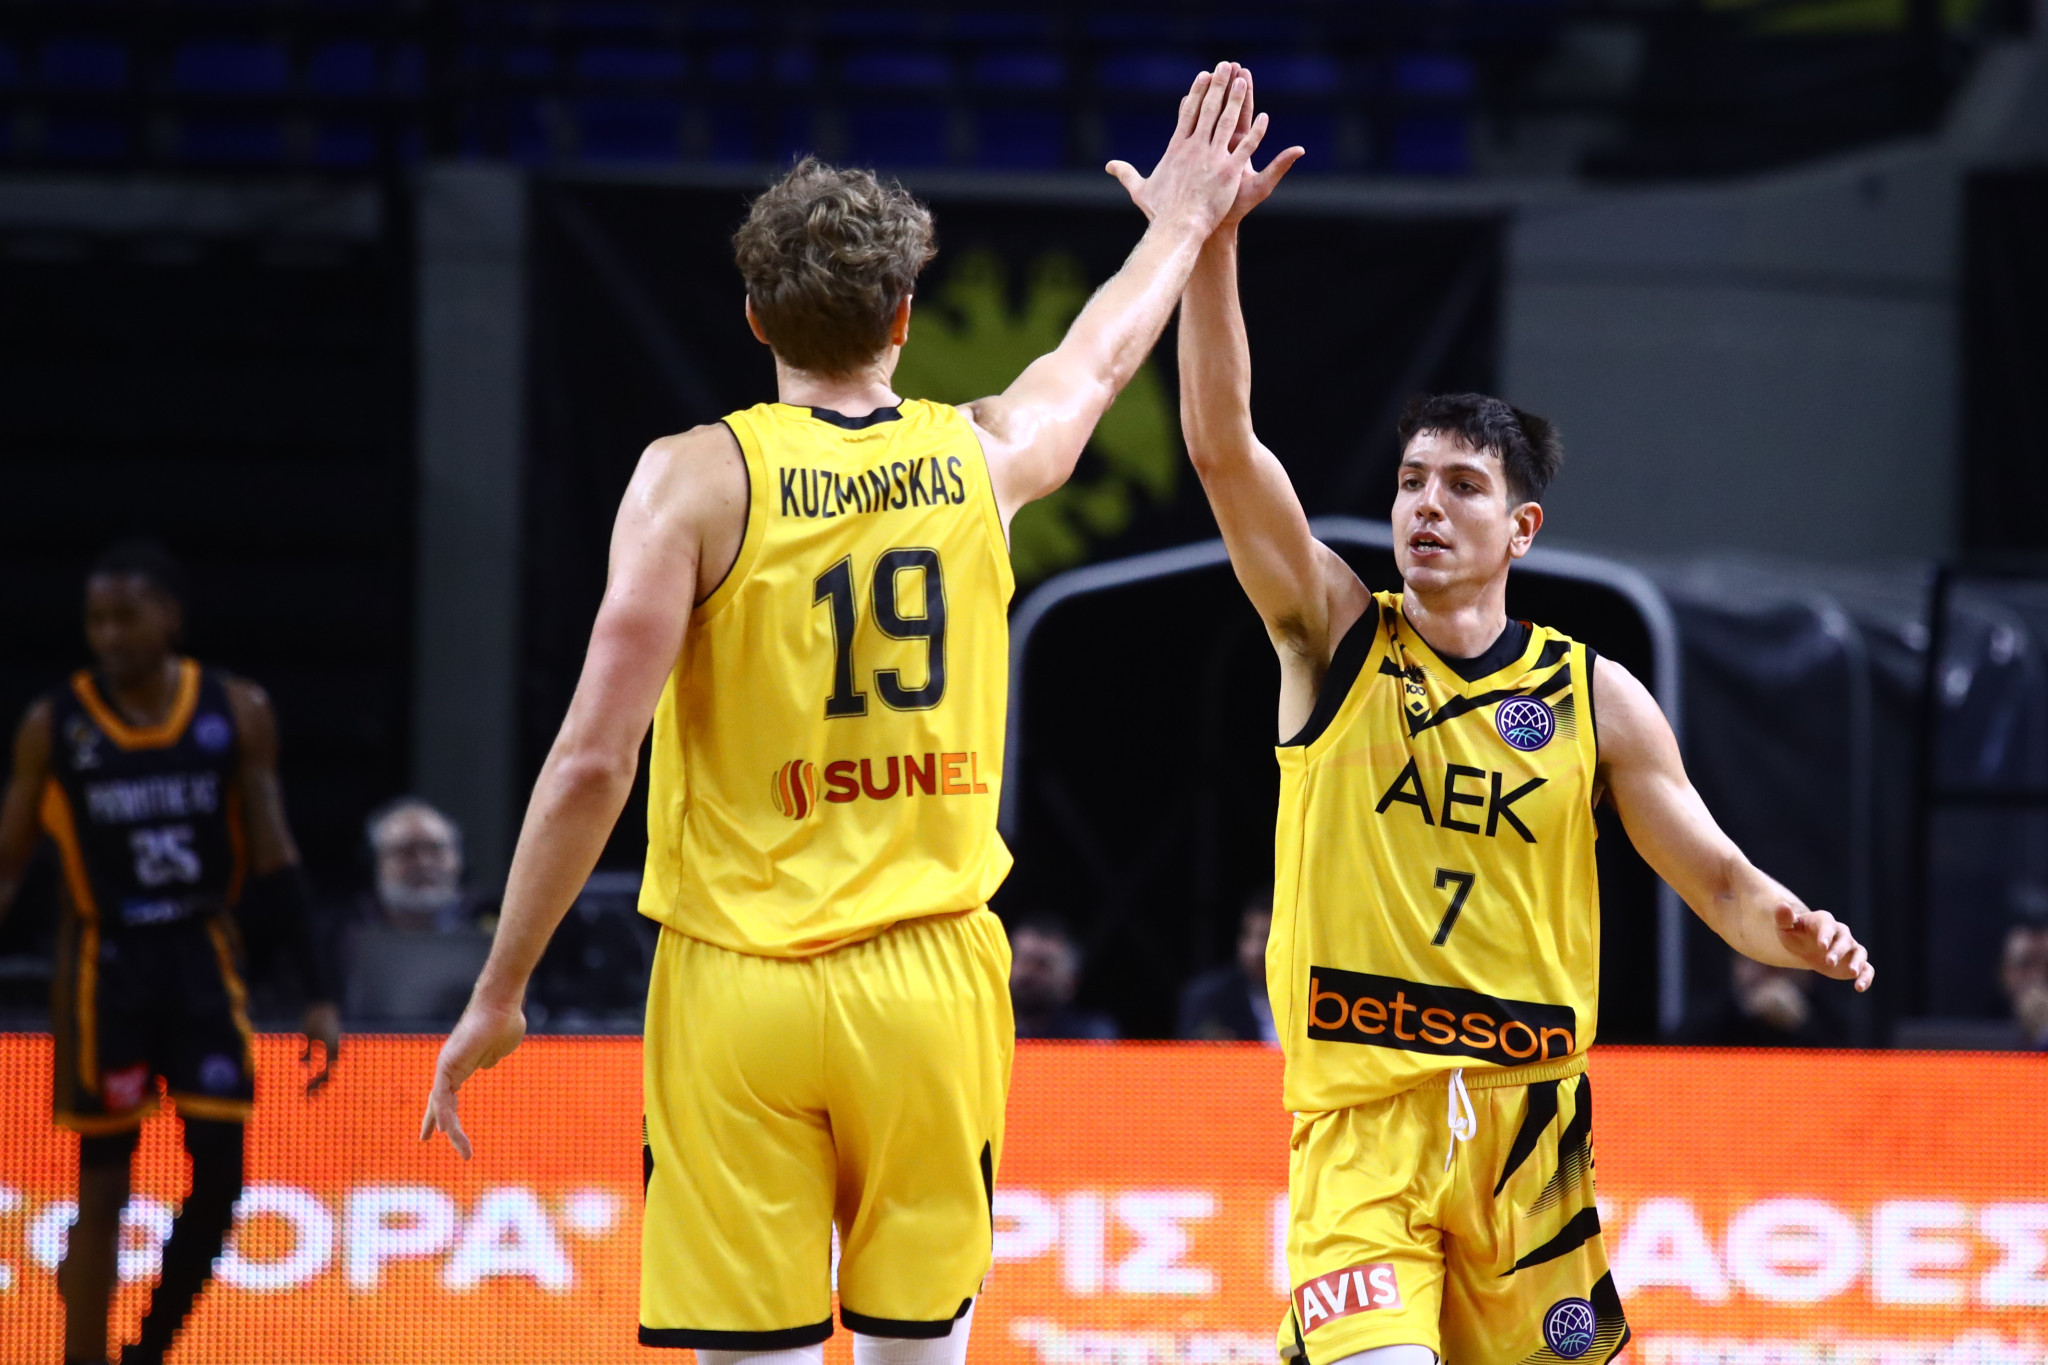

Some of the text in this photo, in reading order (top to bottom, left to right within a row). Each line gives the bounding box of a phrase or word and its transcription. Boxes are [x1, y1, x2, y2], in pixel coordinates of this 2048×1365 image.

[779, 455, 966, 519] KUZMINSKAS
[812, 546, 948, 720] 19
[1405, 683, 1427, 696] 100
[823, 751, 989, 803] SUNEL
[1375, 755, 1549, 843] AEK
[128, 825, 202, 887] 25
[1431, 867, 1476, 947] 7
[1307, 977, 1575, 1062] betsson
[1302, 1267, 1397, 1330] AVIS
